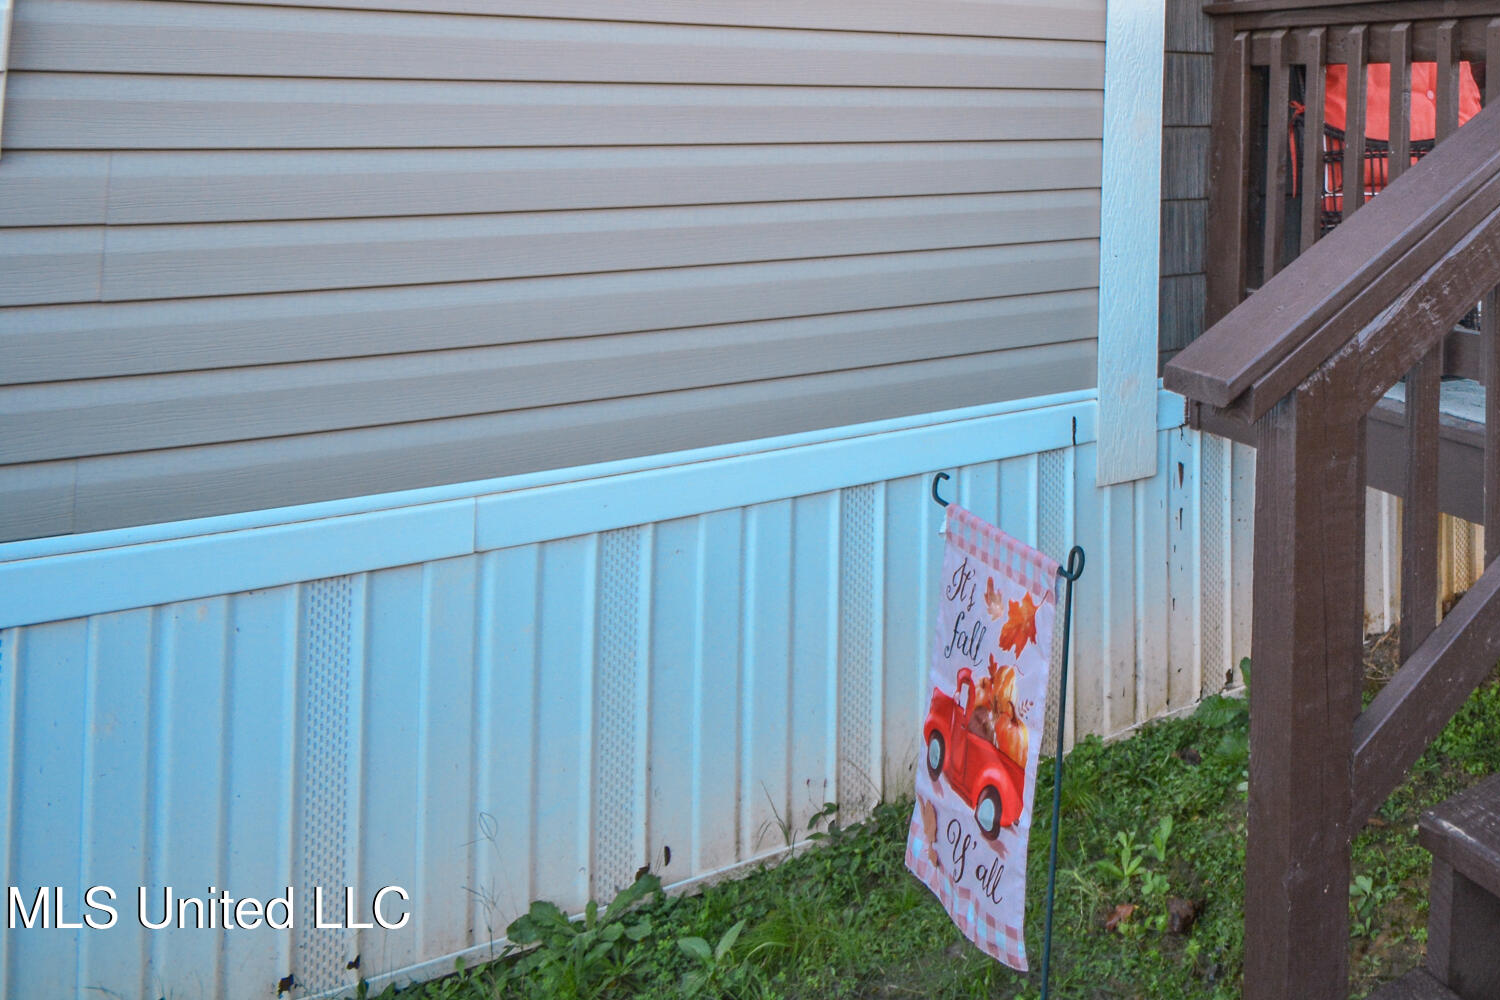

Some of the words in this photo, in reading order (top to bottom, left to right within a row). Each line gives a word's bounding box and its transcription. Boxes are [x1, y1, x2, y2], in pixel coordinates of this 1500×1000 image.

[946, 556, 976, 612] It's
[944, 610, 987, 667] fall
[946, 818, 1005, 905] Y'all
